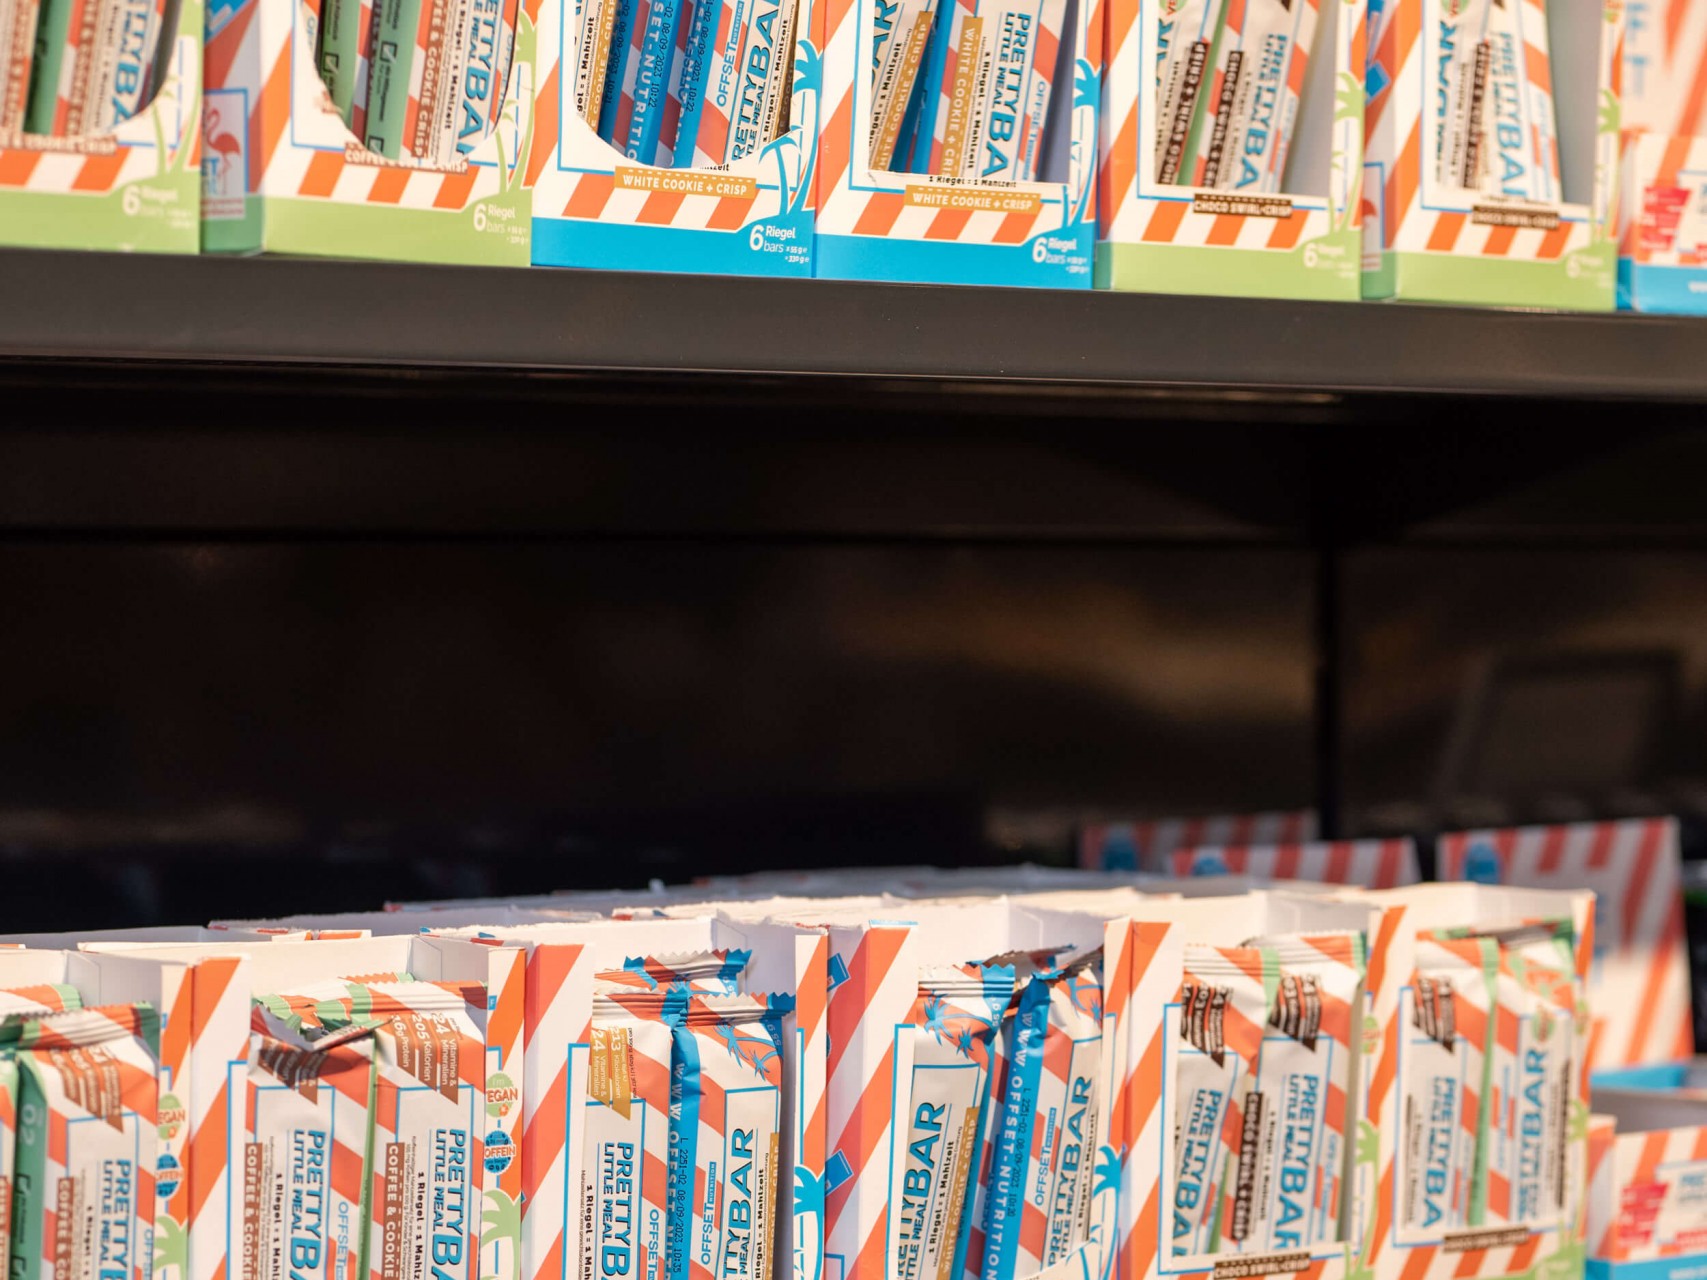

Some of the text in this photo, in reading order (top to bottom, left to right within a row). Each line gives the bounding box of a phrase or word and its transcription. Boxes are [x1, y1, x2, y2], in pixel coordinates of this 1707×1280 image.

[1000, 12, 1014, 63] LITTLE
[717, 45, 736, 107] OFFSET
[623, 175, 659, 189] WHITE
[663, 176, 703, 192] COOKIE
[716, 181, 747, 195] CRISP
[913, 192, 948, 205] WHITE
[951, 193, 991, 208] COOKIE
[1003, 196, 1033, 210] CRISP
[473, 204, 516, 232] 6 Riegel
[749, 225, 796, 251] 6 Riegel
[764, 241, 784, 253] bars
[1032, 236, 1047, 264] 6
[485, 1087, 518, 1102] EGAN
[1287, 1073, 1300, 1120] LITTLE
[244, 1145, 258, 1203] COFFEE
[291, 1130, 305, 1234] LITTLE MEAL
[387, 1146, 399, 1202] COFFEE
[415, 1182, 426, 1222] Riegel
[432, 1129, 447, 1232] LITTLE MEAL
[601, 1142, 615, 1244] LITTLE MEAL
[1034, 1146, 1051, 1206] OFFSET
[337, 1201, 349, 1266] OFFSET
[585, 1195, 594, 1234] Riegel
[648, 1208, 659, 1271] OFFSET
[673, 1190, 686, 1247] 08/09/2023
[701, 1204, 714, 1265] OFFSET
[912, 1200, 928, 1241] MEAL
[243, 1222, 255, 1280] COOKIE
[384, 1221, 396, 1278] COOKIE
